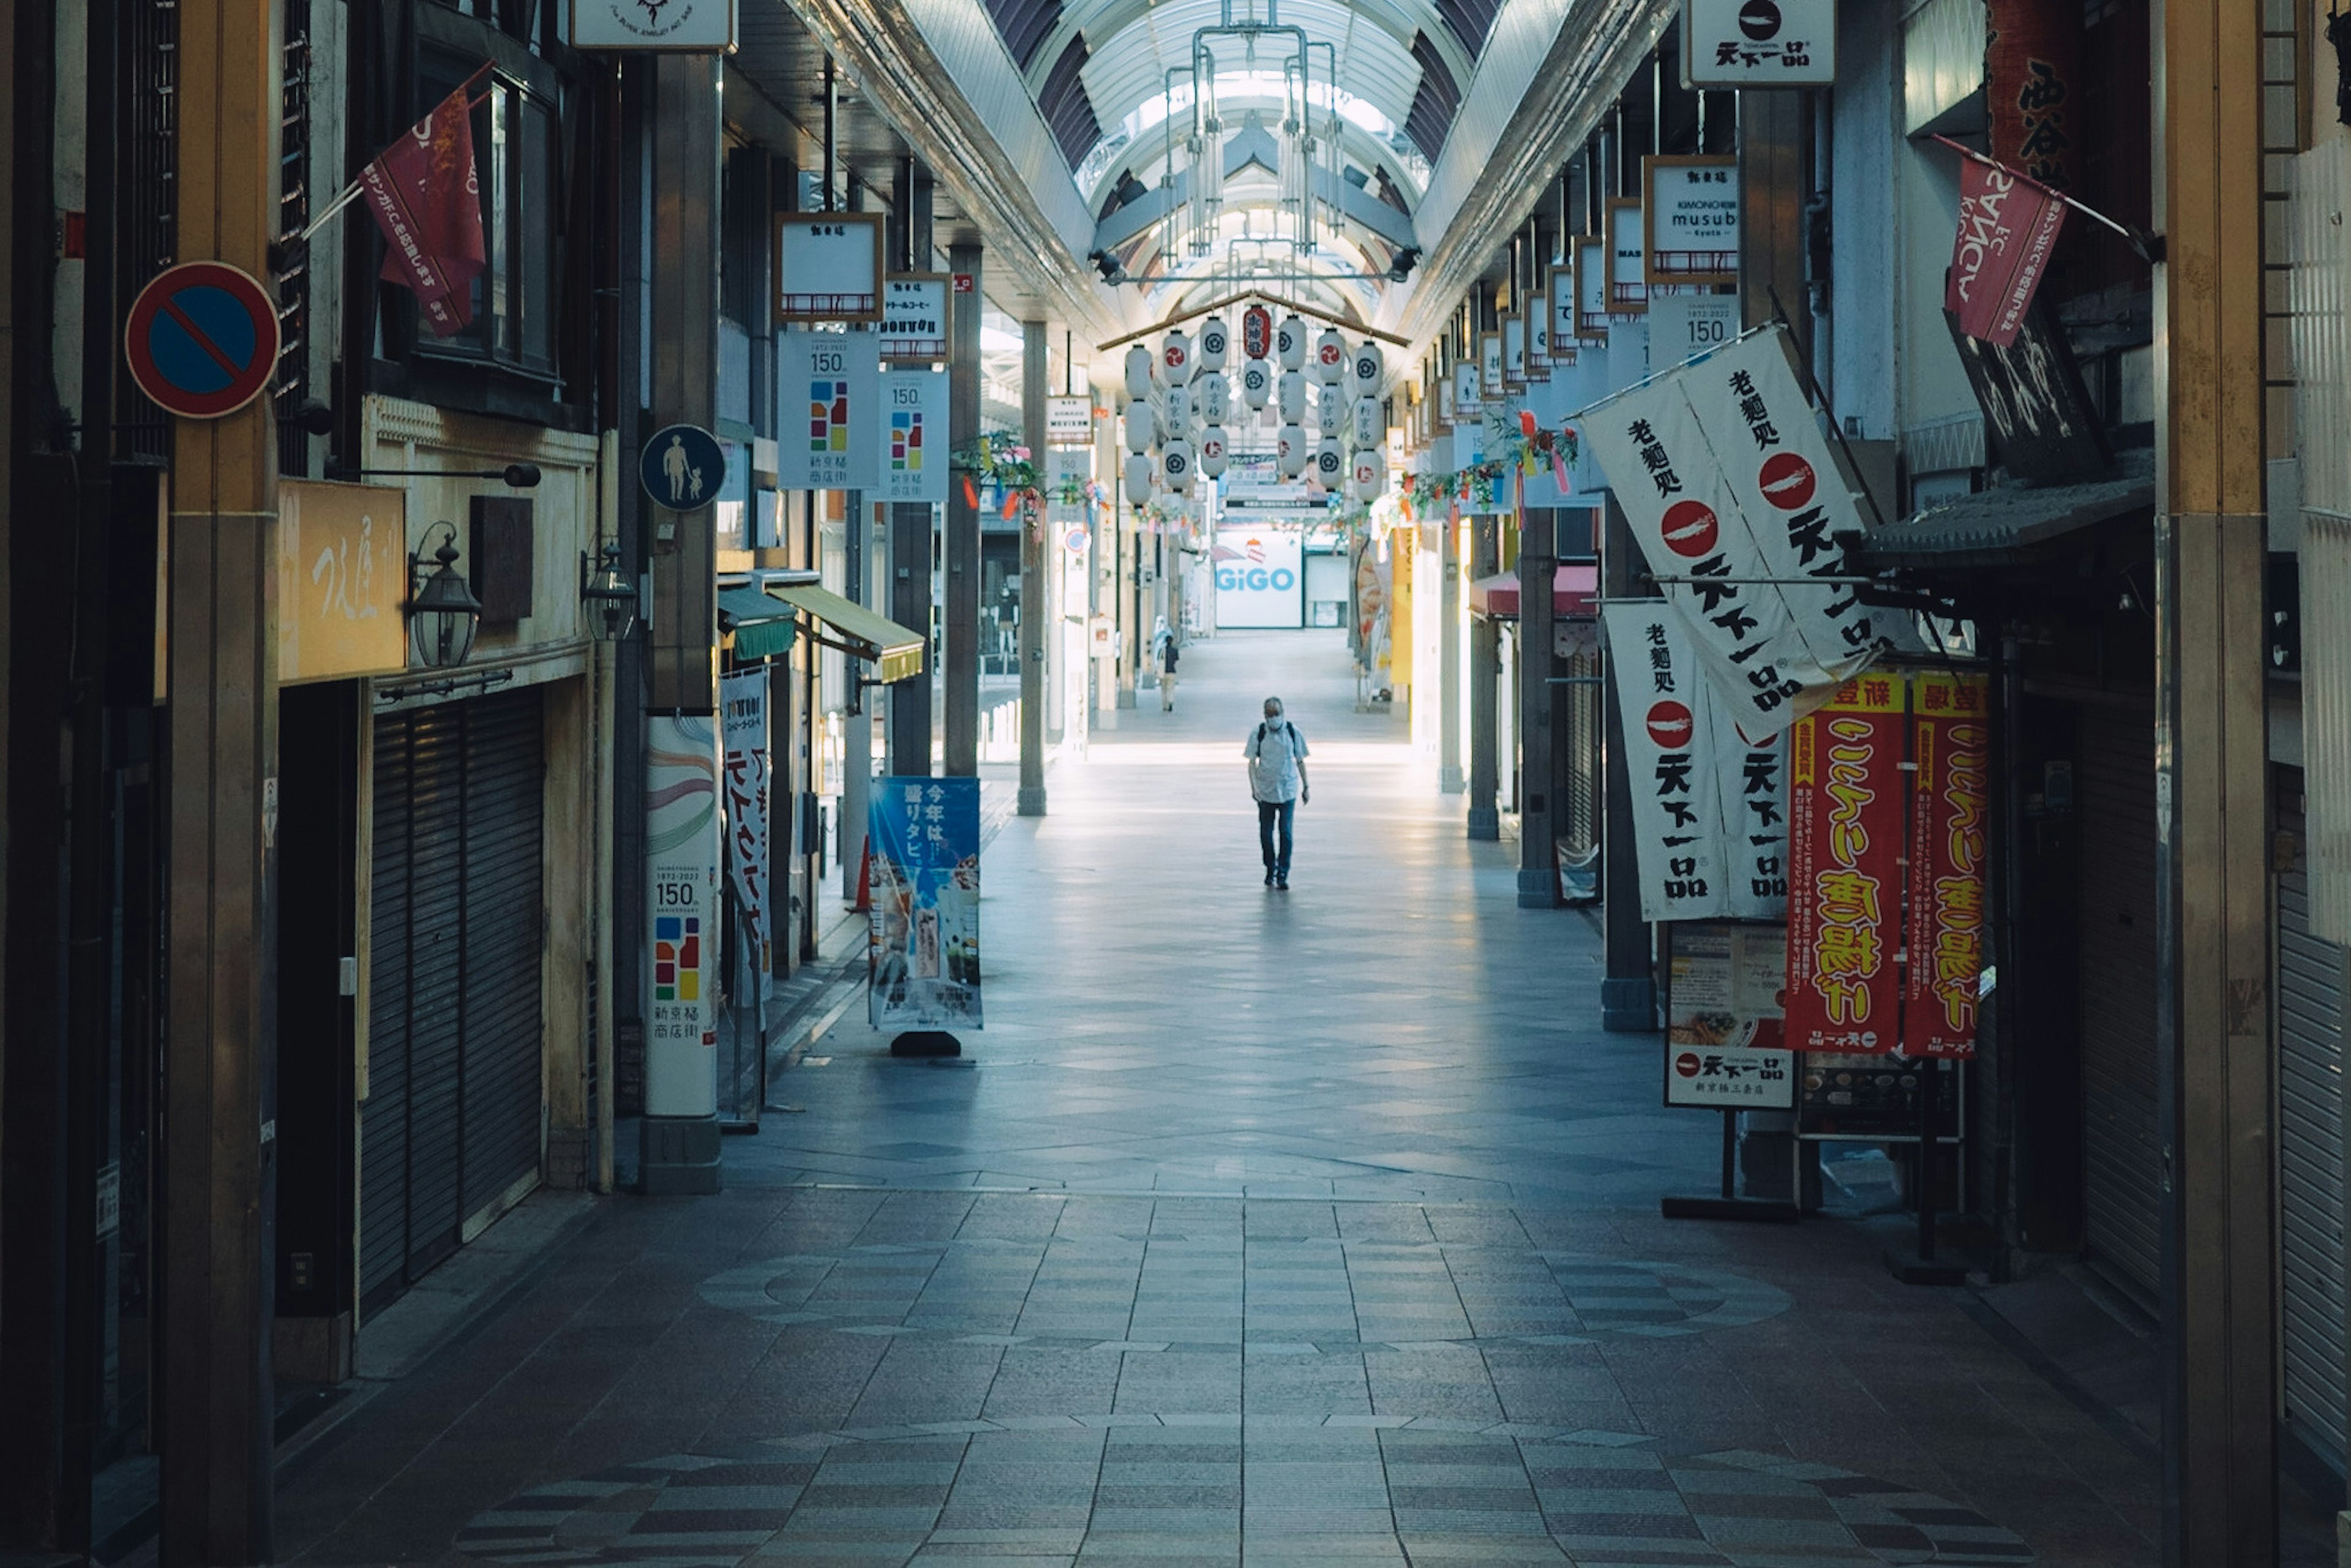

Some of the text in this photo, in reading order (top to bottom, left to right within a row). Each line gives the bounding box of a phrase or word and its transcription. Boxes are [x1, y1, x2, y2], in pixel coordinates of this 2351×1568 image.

[1716, 41, 1810, 68] 天下一品
[1216, 568, 1294, 591] GiGO
[1691, 552, 1803, 712] 天下一品
[1655, 754, 1709, 899] 天下一品
[1743, 754, 1788, 898] 天下一品
[1703, 1055, 1784, 1080] 天下一品
